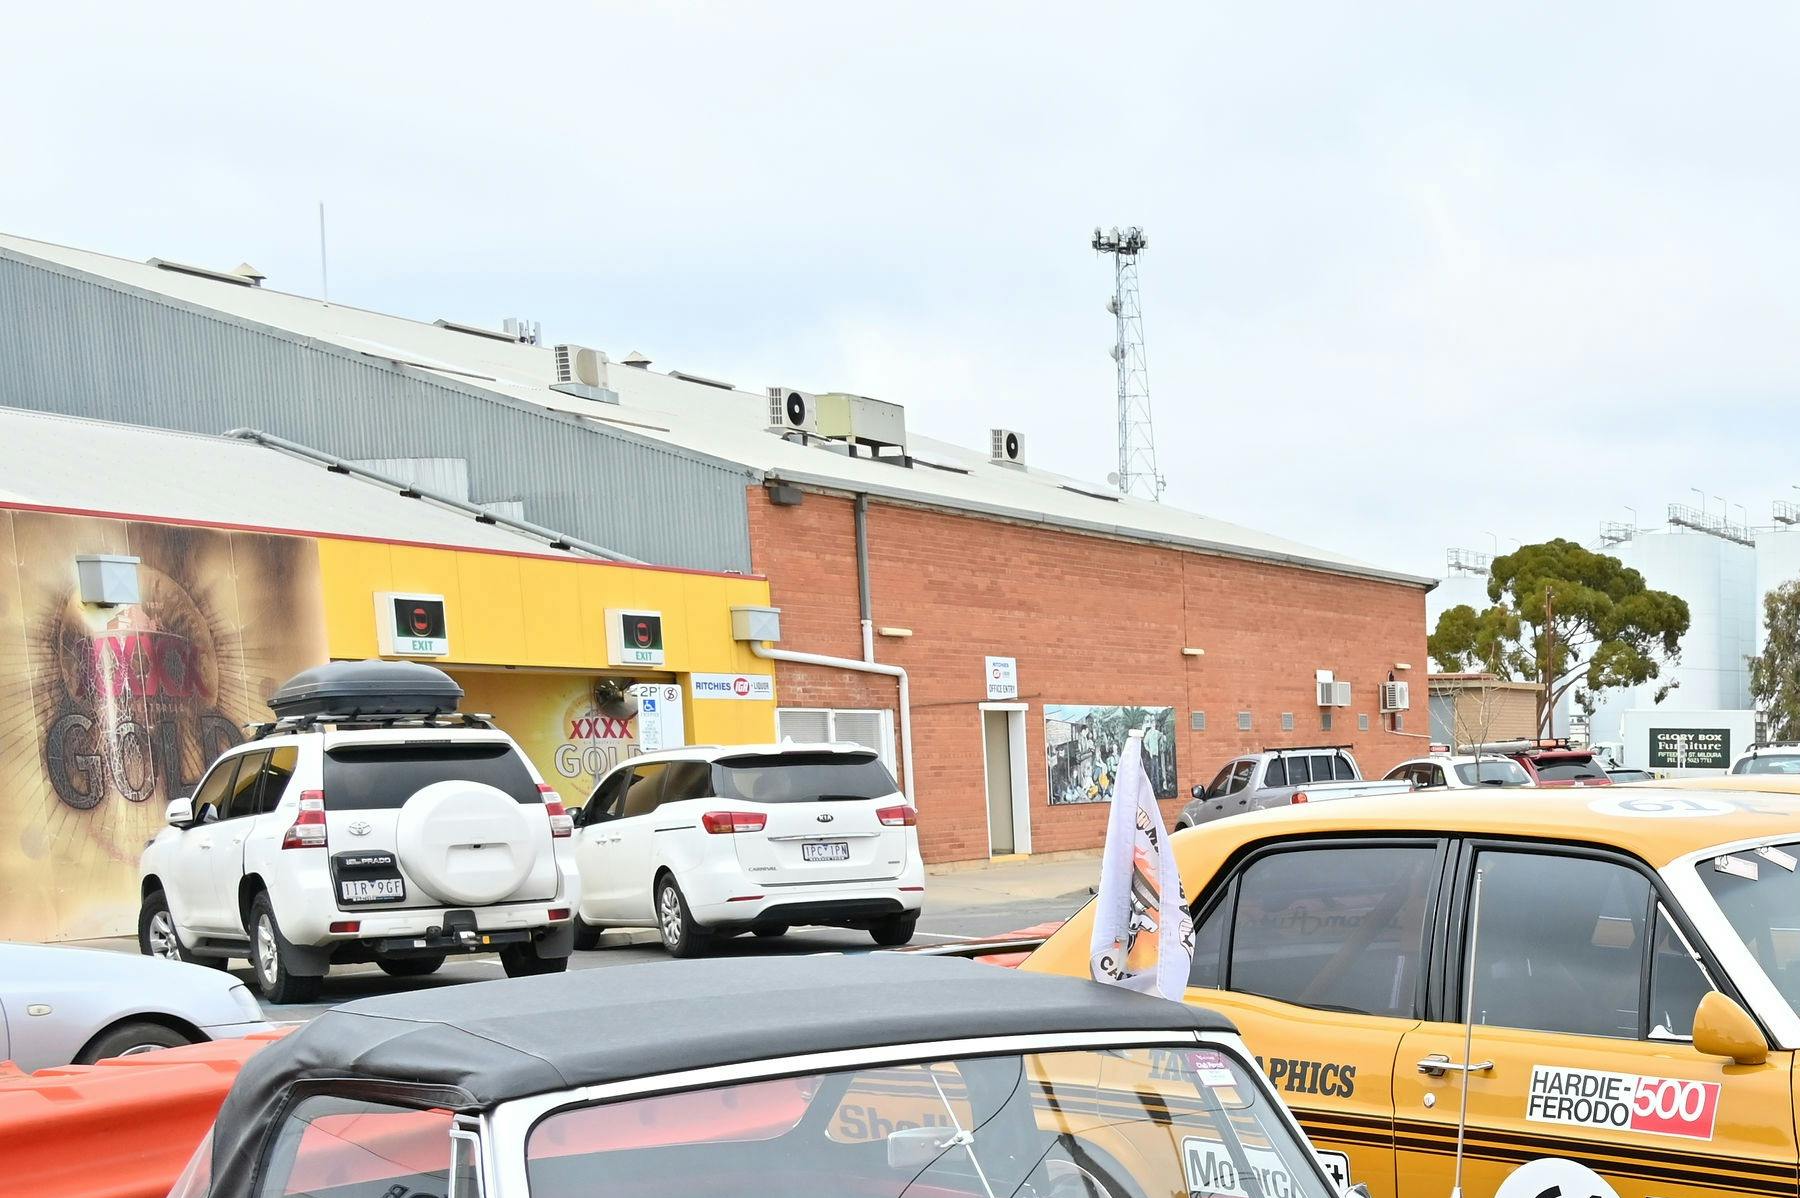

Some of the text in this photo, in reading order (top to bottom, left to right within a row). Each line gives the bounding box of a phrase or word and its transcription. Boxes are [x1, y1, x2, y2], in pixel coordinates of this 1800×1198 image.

[412, 640, 433, 651] EXIT
[635, 651, 653, 661] EXIT
[640, 686, 657, 697] 2P
[695, 682, 731, 691] RITCHIES
[569, 717, 633, 740] XXXX
[1657, 733, 1694, 741] GLORY
[817, 814, 833, 822] KIA
[377, 880, 400, 894] 9GF
[1255, 1056, 1356, 1099] PHICS
[1532, 1070, 1631, 1101] HARDIE-
[1632, 1076, 1706, 1123] 500
[1528, 1094, 1630, 1127] FERODO
